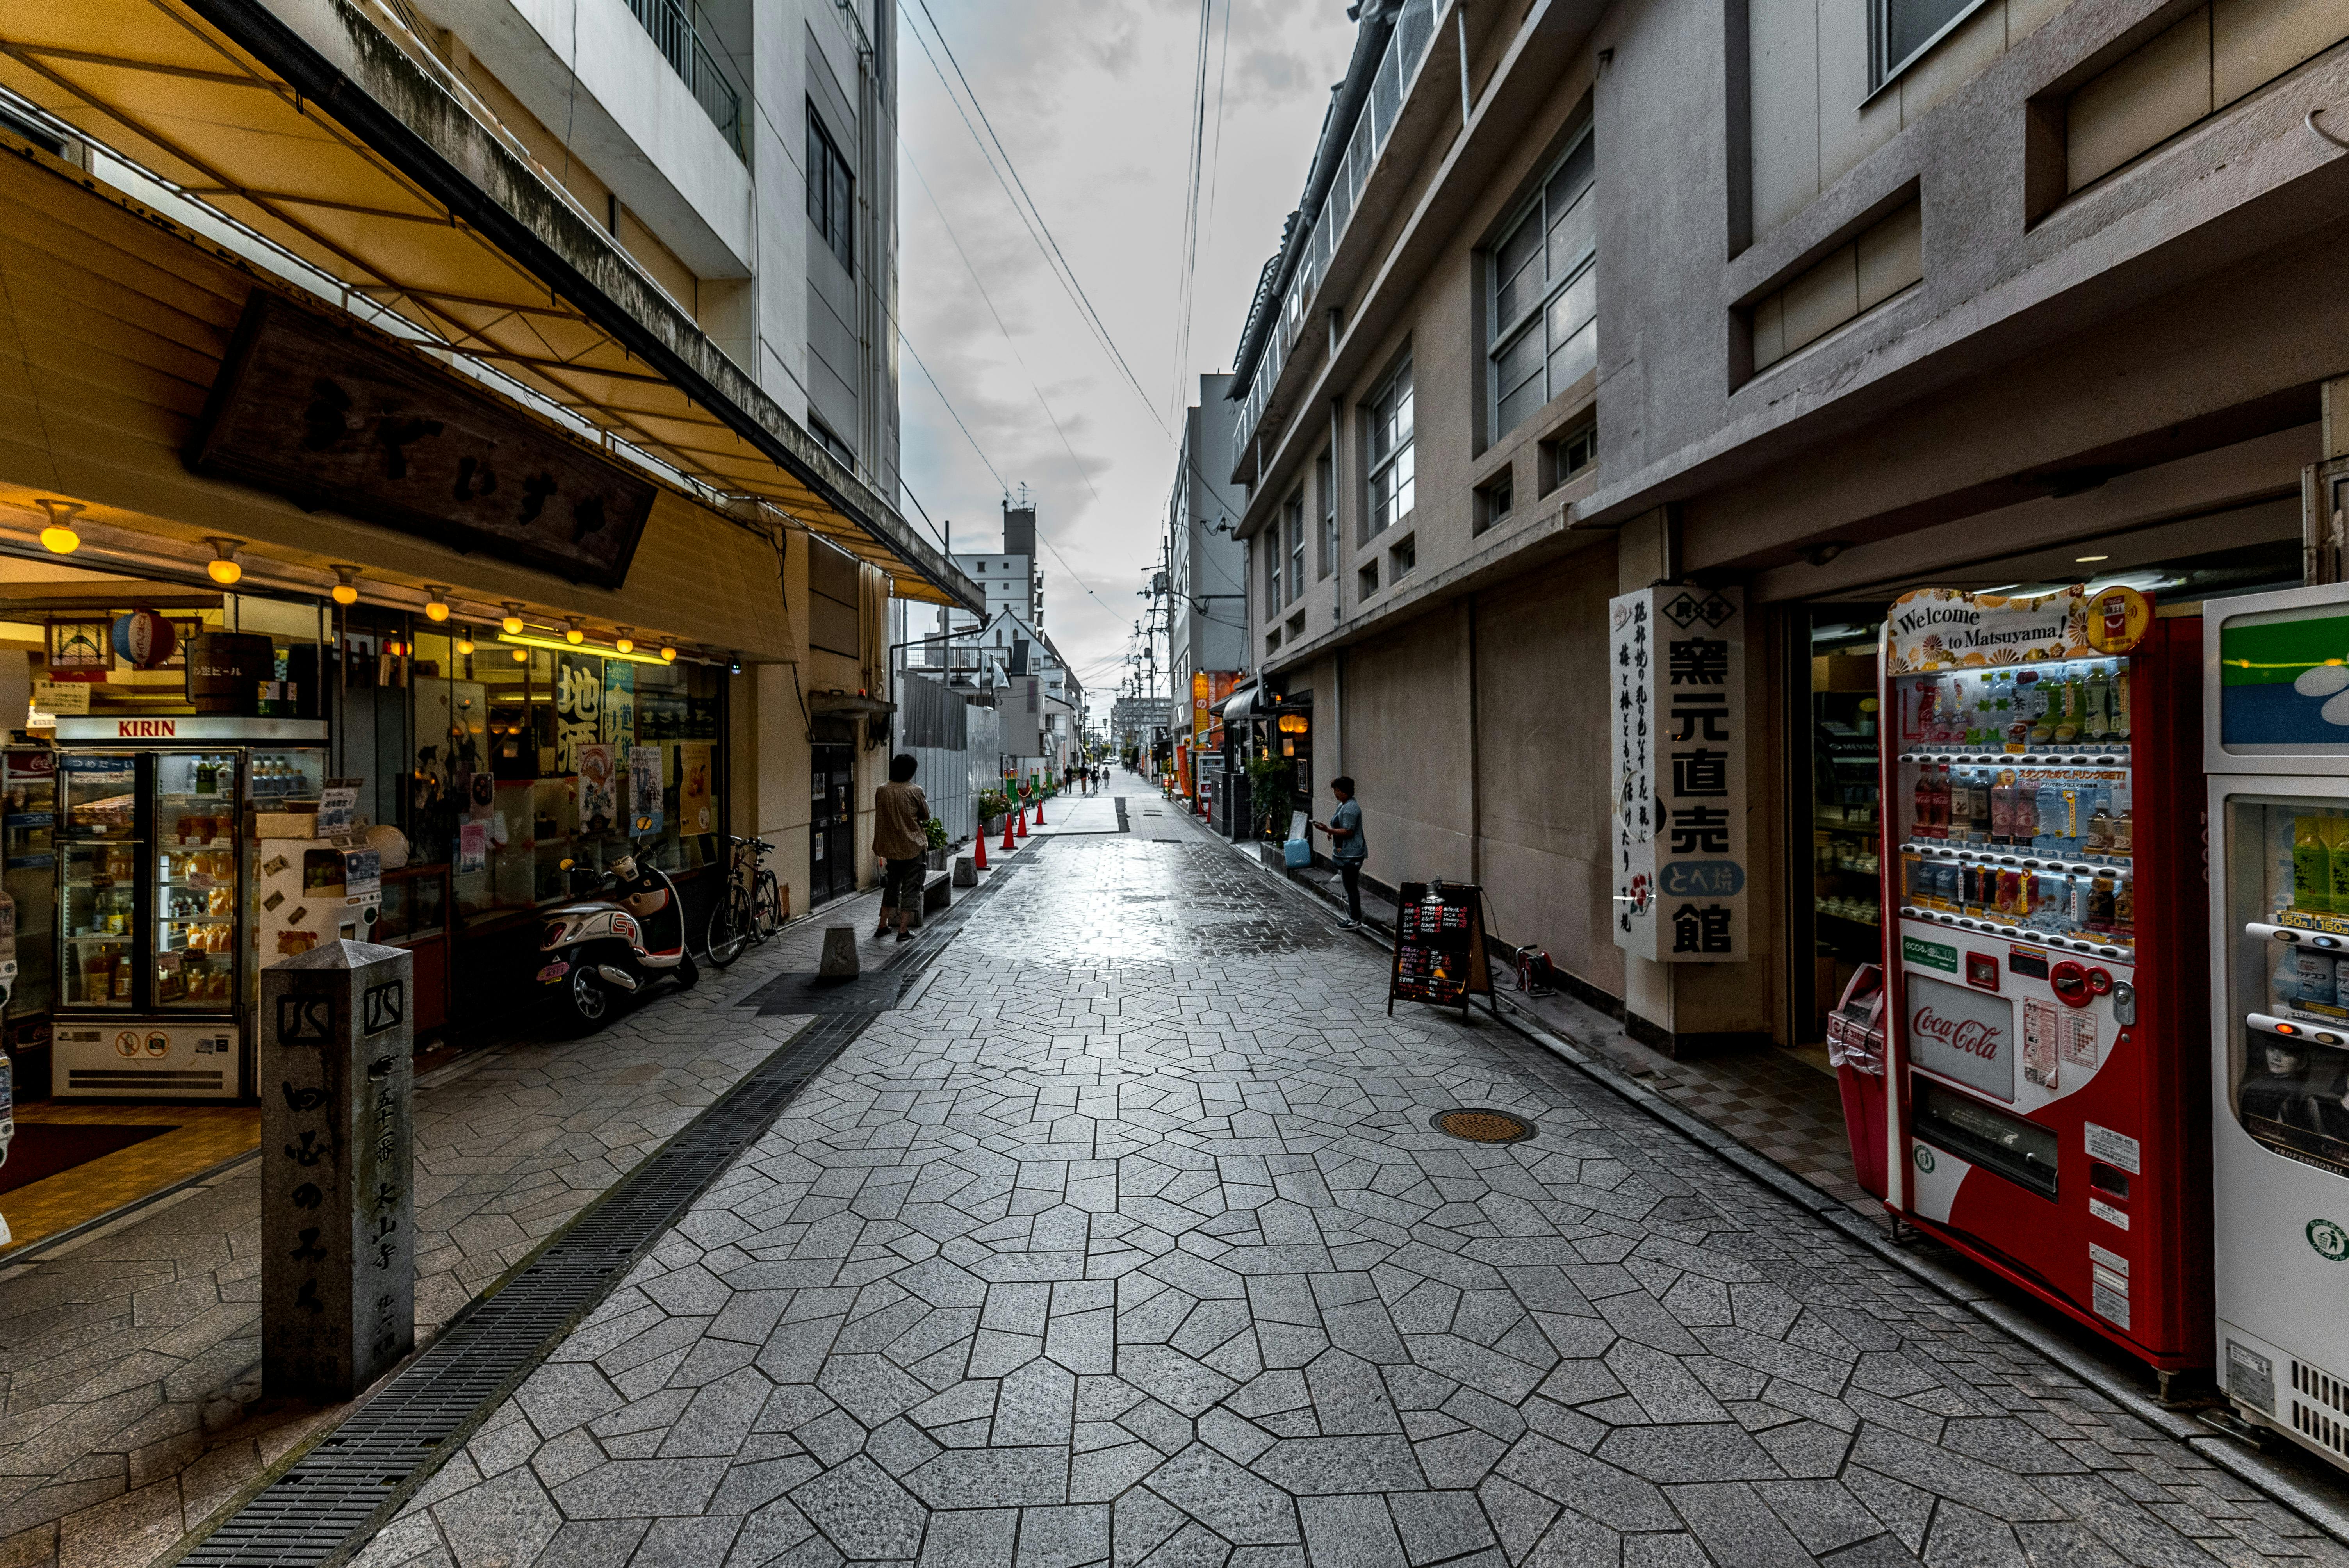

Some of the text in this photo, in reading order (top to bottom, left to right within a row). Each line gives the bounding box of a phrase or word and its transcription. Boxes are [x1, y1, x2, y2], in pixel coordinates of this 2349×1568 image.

[1898, 608, 1980, 635] Welcome
[1948, 615, 2067, 651] to Matsuyama!
[119, 721, 175, 736] KIRIN
[558, 664, 600, 774] 地酒
[1670, 638, 1728, 853] 窯元直売
[1669, 865, 1733, 893] とべ焼
[1672, 904, 1731, 953] 館
[2280, 914, 2308, 928] 150円
[1913, 1006, 2003, 1060] Coca-Cola
[2274, 1146, 2344, 1176] PROFESSIONAL
[372, 1183, 397, 1270] 太山寺
